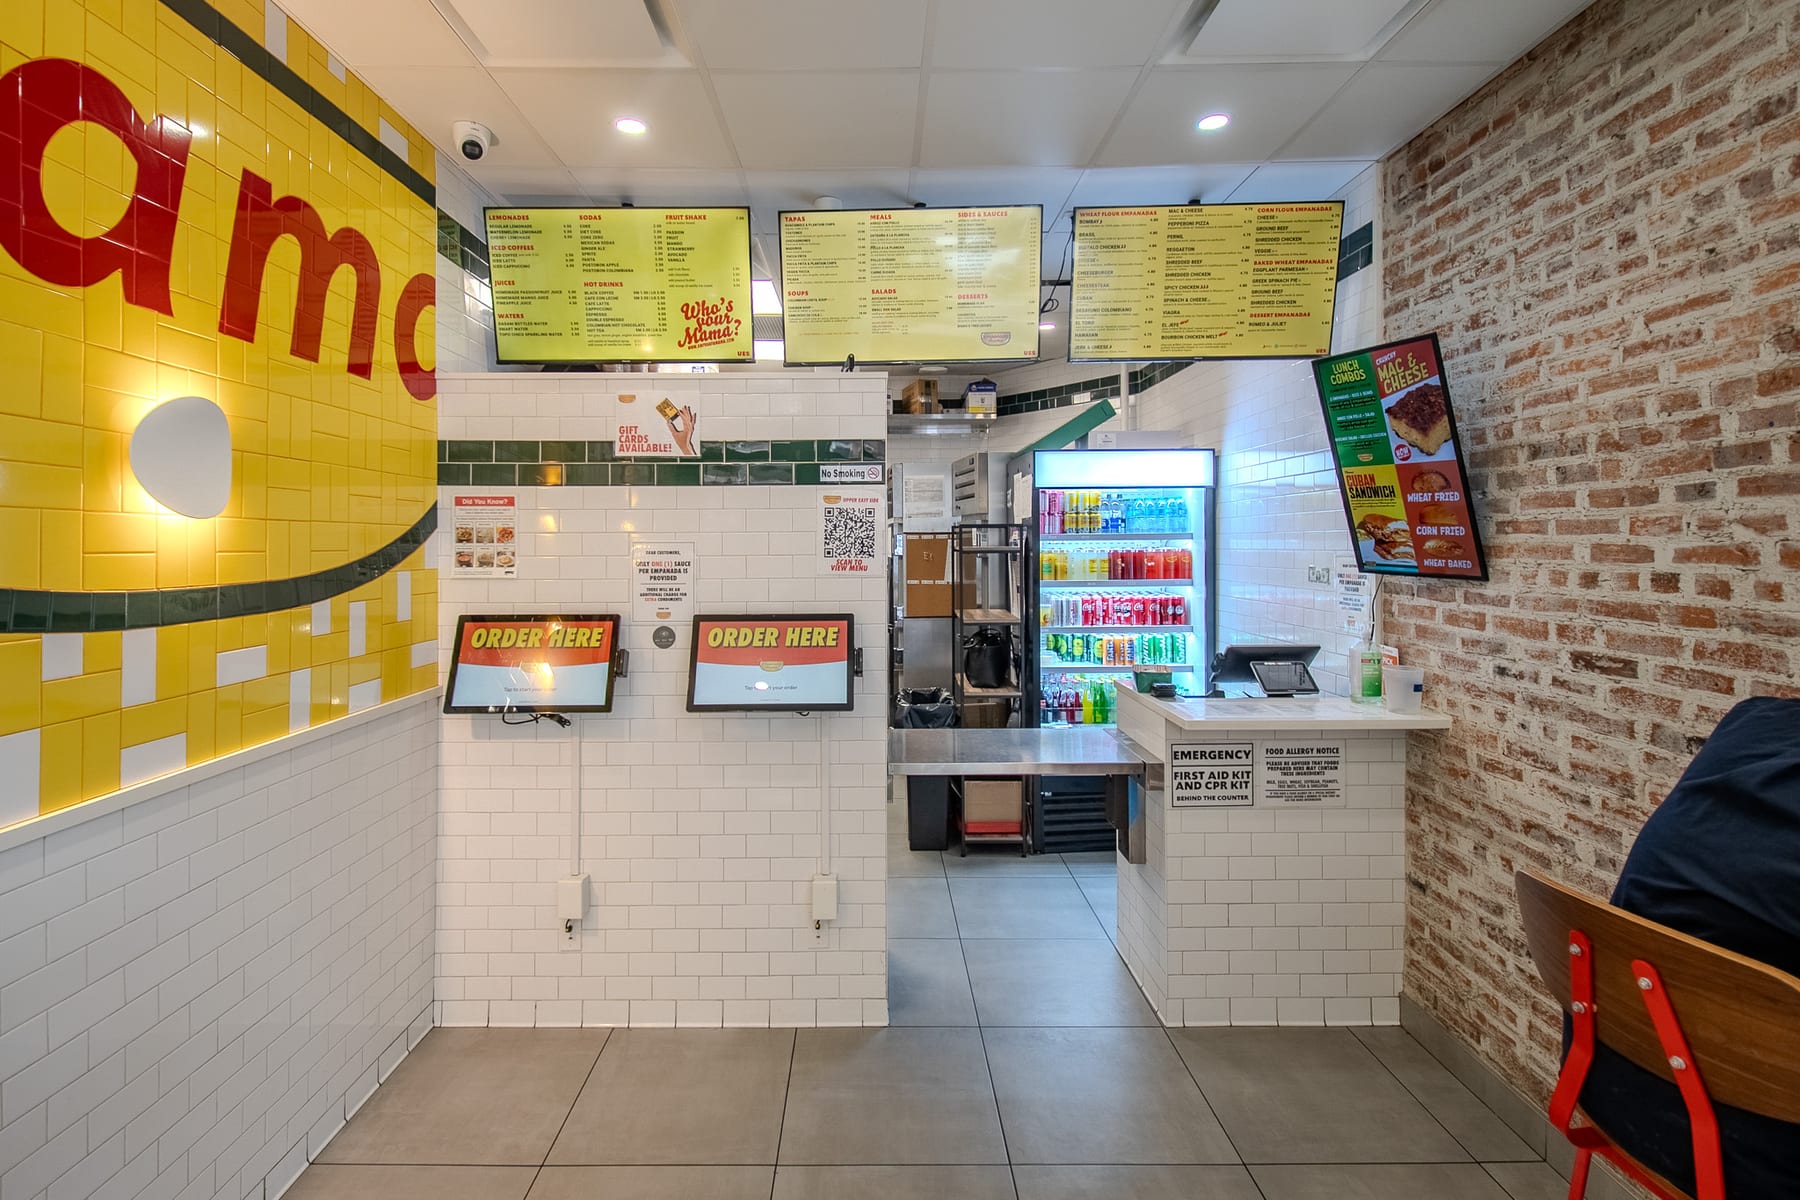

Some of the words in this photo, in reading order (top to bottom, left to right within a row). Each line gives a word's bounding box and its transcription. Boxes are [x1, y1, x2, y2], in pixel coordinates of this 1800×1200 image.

[680, 297, 733, 320] Who's
[696, 312, 734, 332] your
[678, 319, 742, 348] Mama?
[1331, 359, 1360, 373] LUNCH
[1377, 358, 1404, 382] MAC
[1407, 352, 1417, 367] &
[1330, 369, 1366, 385] COMBOS
[1383, 362, 1429, 394] CHEESE
[619, 426, 639, 435] GIFT
[619, 435, 649, 444] CARDS
[619, 443, 672, 452] AVAILABLE!
[821, 469, 833, 478] No
[833, 469, 865, 480] Smoking
[1346, 473, 1375, 488] CUBAN
[1349, 485, 1396, 500] SANDWICH
[1407, 492, 1433, 503] WHEAT
[1434, 491, 1460, 501] FRIED
[1416, 526, 1438, 536] CORN
[1440, 526, 1466, 536] FRIED
[848, 564, 868, 572] MENU
[1423, 560, 1446, 568] WHEAT
[1447, 560, 1472, 569] BAKED
[471, 627, 544, 648] ORDER
[548, 627, 605, 648] HERE
[708, 627, 780, 648] ORDER
[785, 626, 840, 648] HERE
[1173, 750, 1252, 761] EMERGENCY
[1265, 748, 1285, 756] FOOD
[1286, 748, 1315, 756] ALLERGY
[1316, 747, 1340, 755] NOTICE
[1174, 771, 1205, 781] FIRST
[1208, 771, 1229, 781] AID
[1232, 771, 1252, 780] KIT
[1176, 781, 1202, 791] AND
[1204, 781, 1228, 791] CPR
[1231, 781, 1250, 790] KIT
